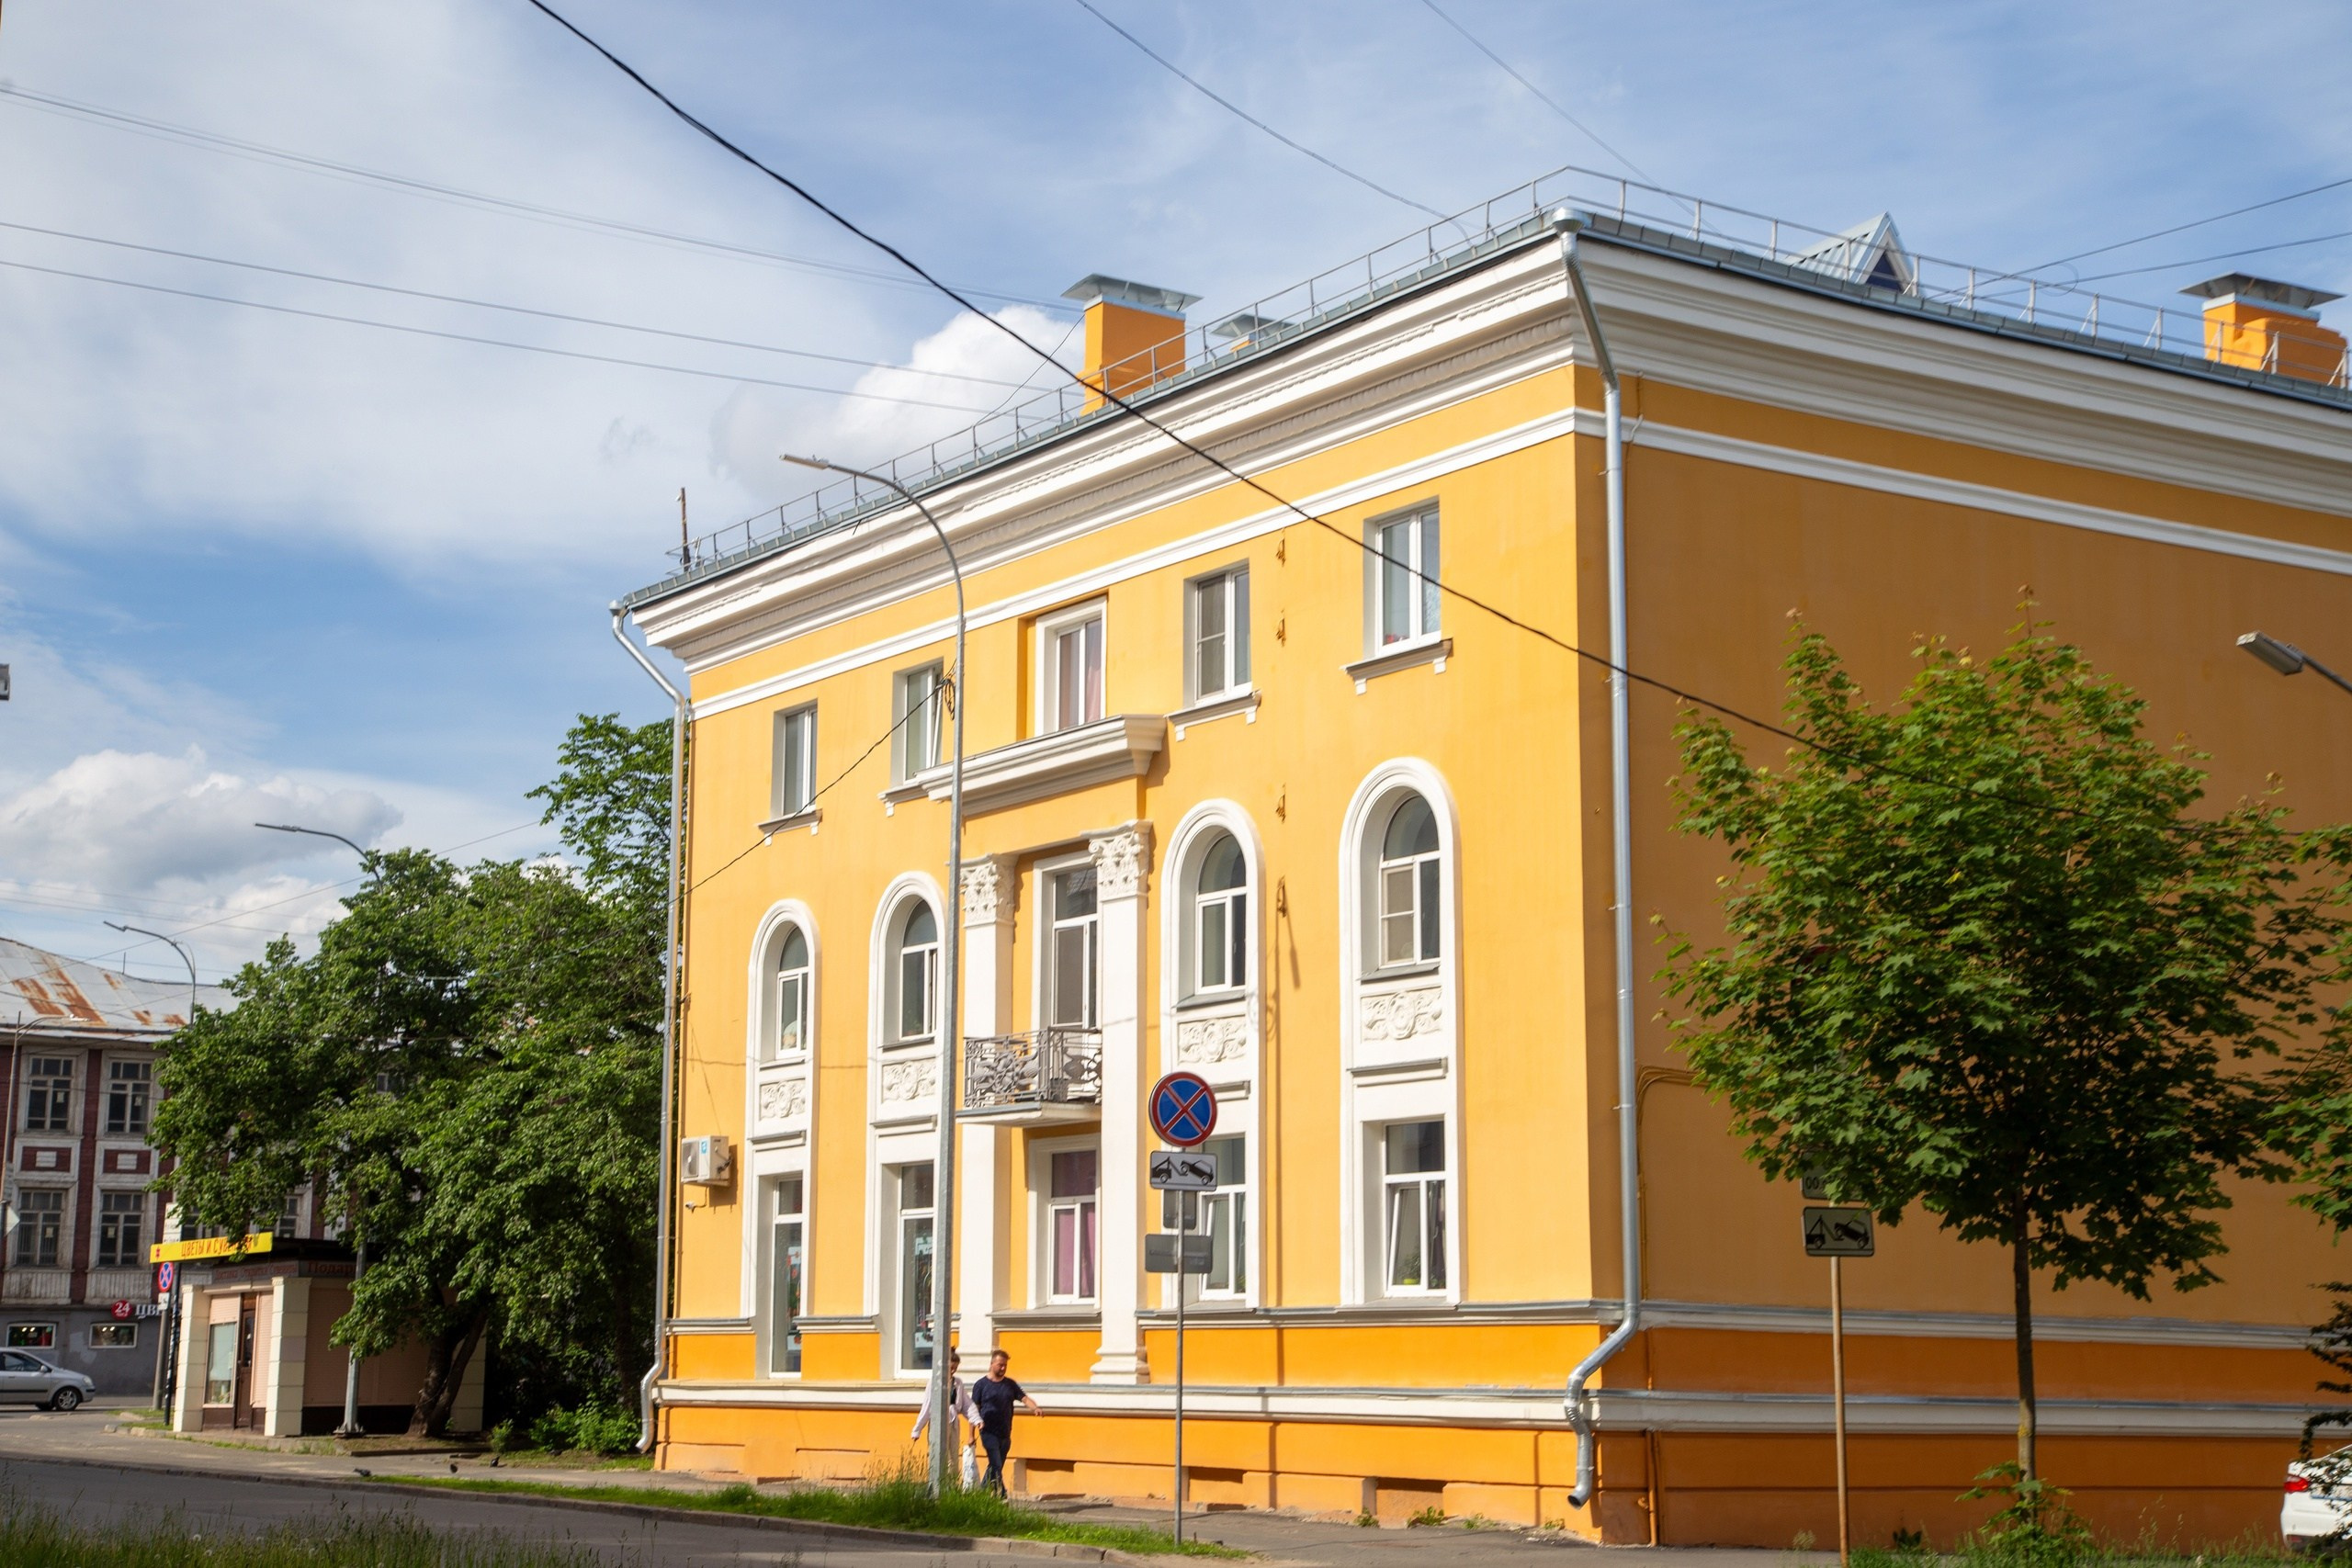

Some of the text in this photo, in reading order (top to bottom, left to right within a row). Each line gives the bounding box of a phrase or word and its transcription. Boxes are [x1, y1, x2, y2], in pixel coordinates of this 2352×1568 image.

[181, 1241, 203, 1259] ЦВЕТЫ
[206, 1239, 212, 1255] И
[115, 1302, 130, 1314] 24
